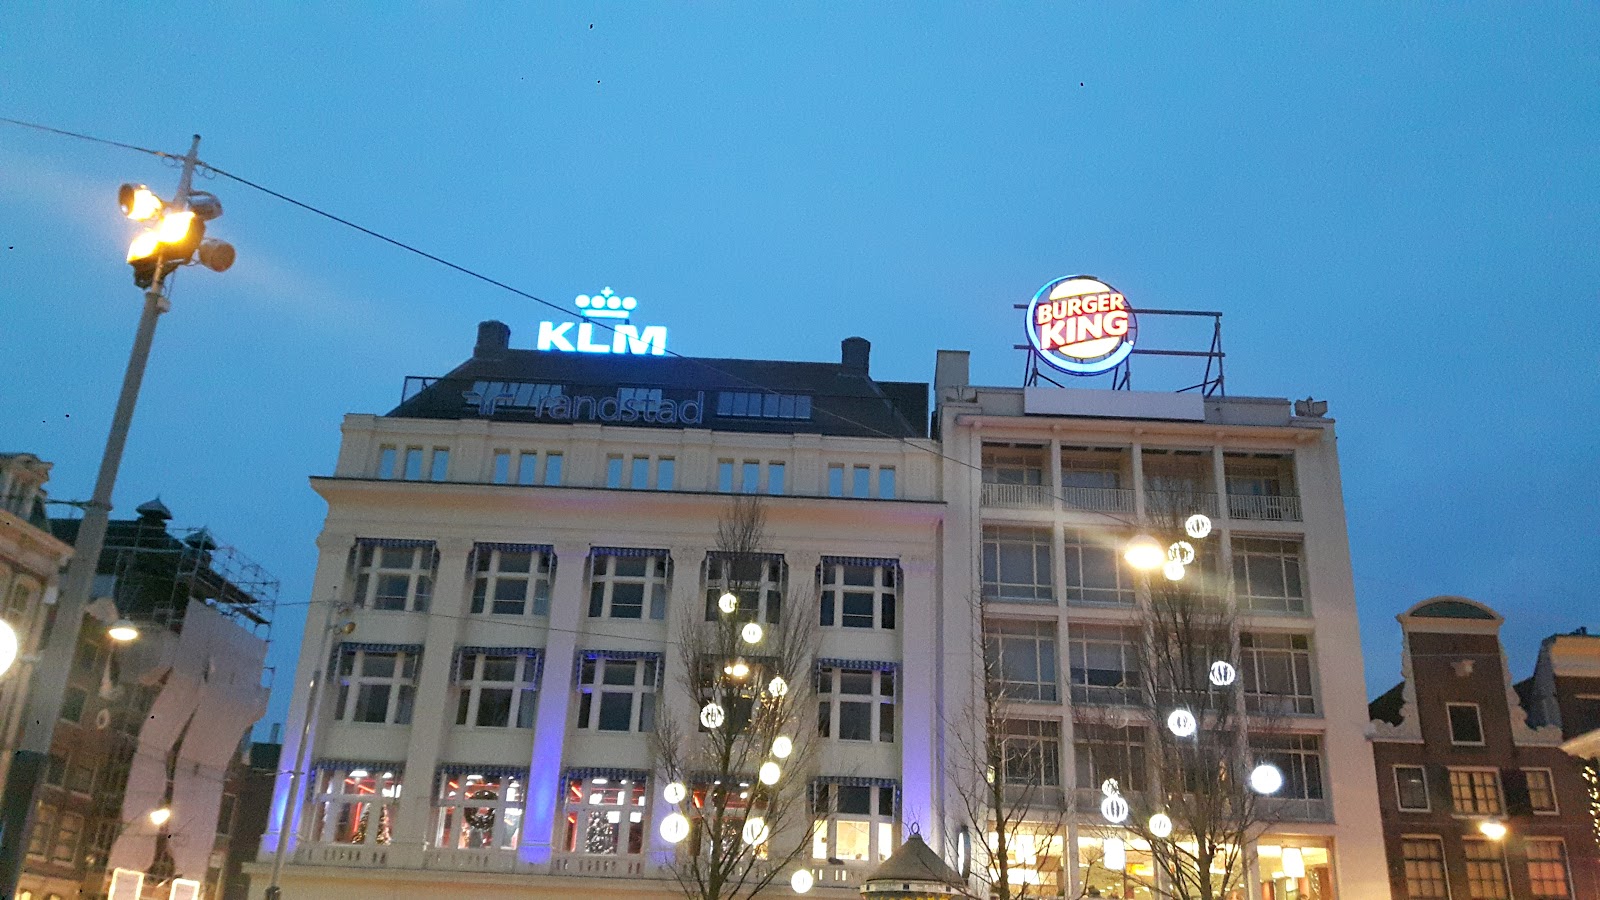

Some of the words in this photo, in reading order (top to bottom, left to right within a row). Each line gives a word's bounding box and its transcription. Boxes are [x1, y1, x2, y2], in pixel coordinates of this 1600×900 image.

[1037, 293, 1125, 325] BURGER
[537, 320, 668, 356] KLM
[1040, 310, 1128, 350] KING
[535, 390, 704, 424] randstad
